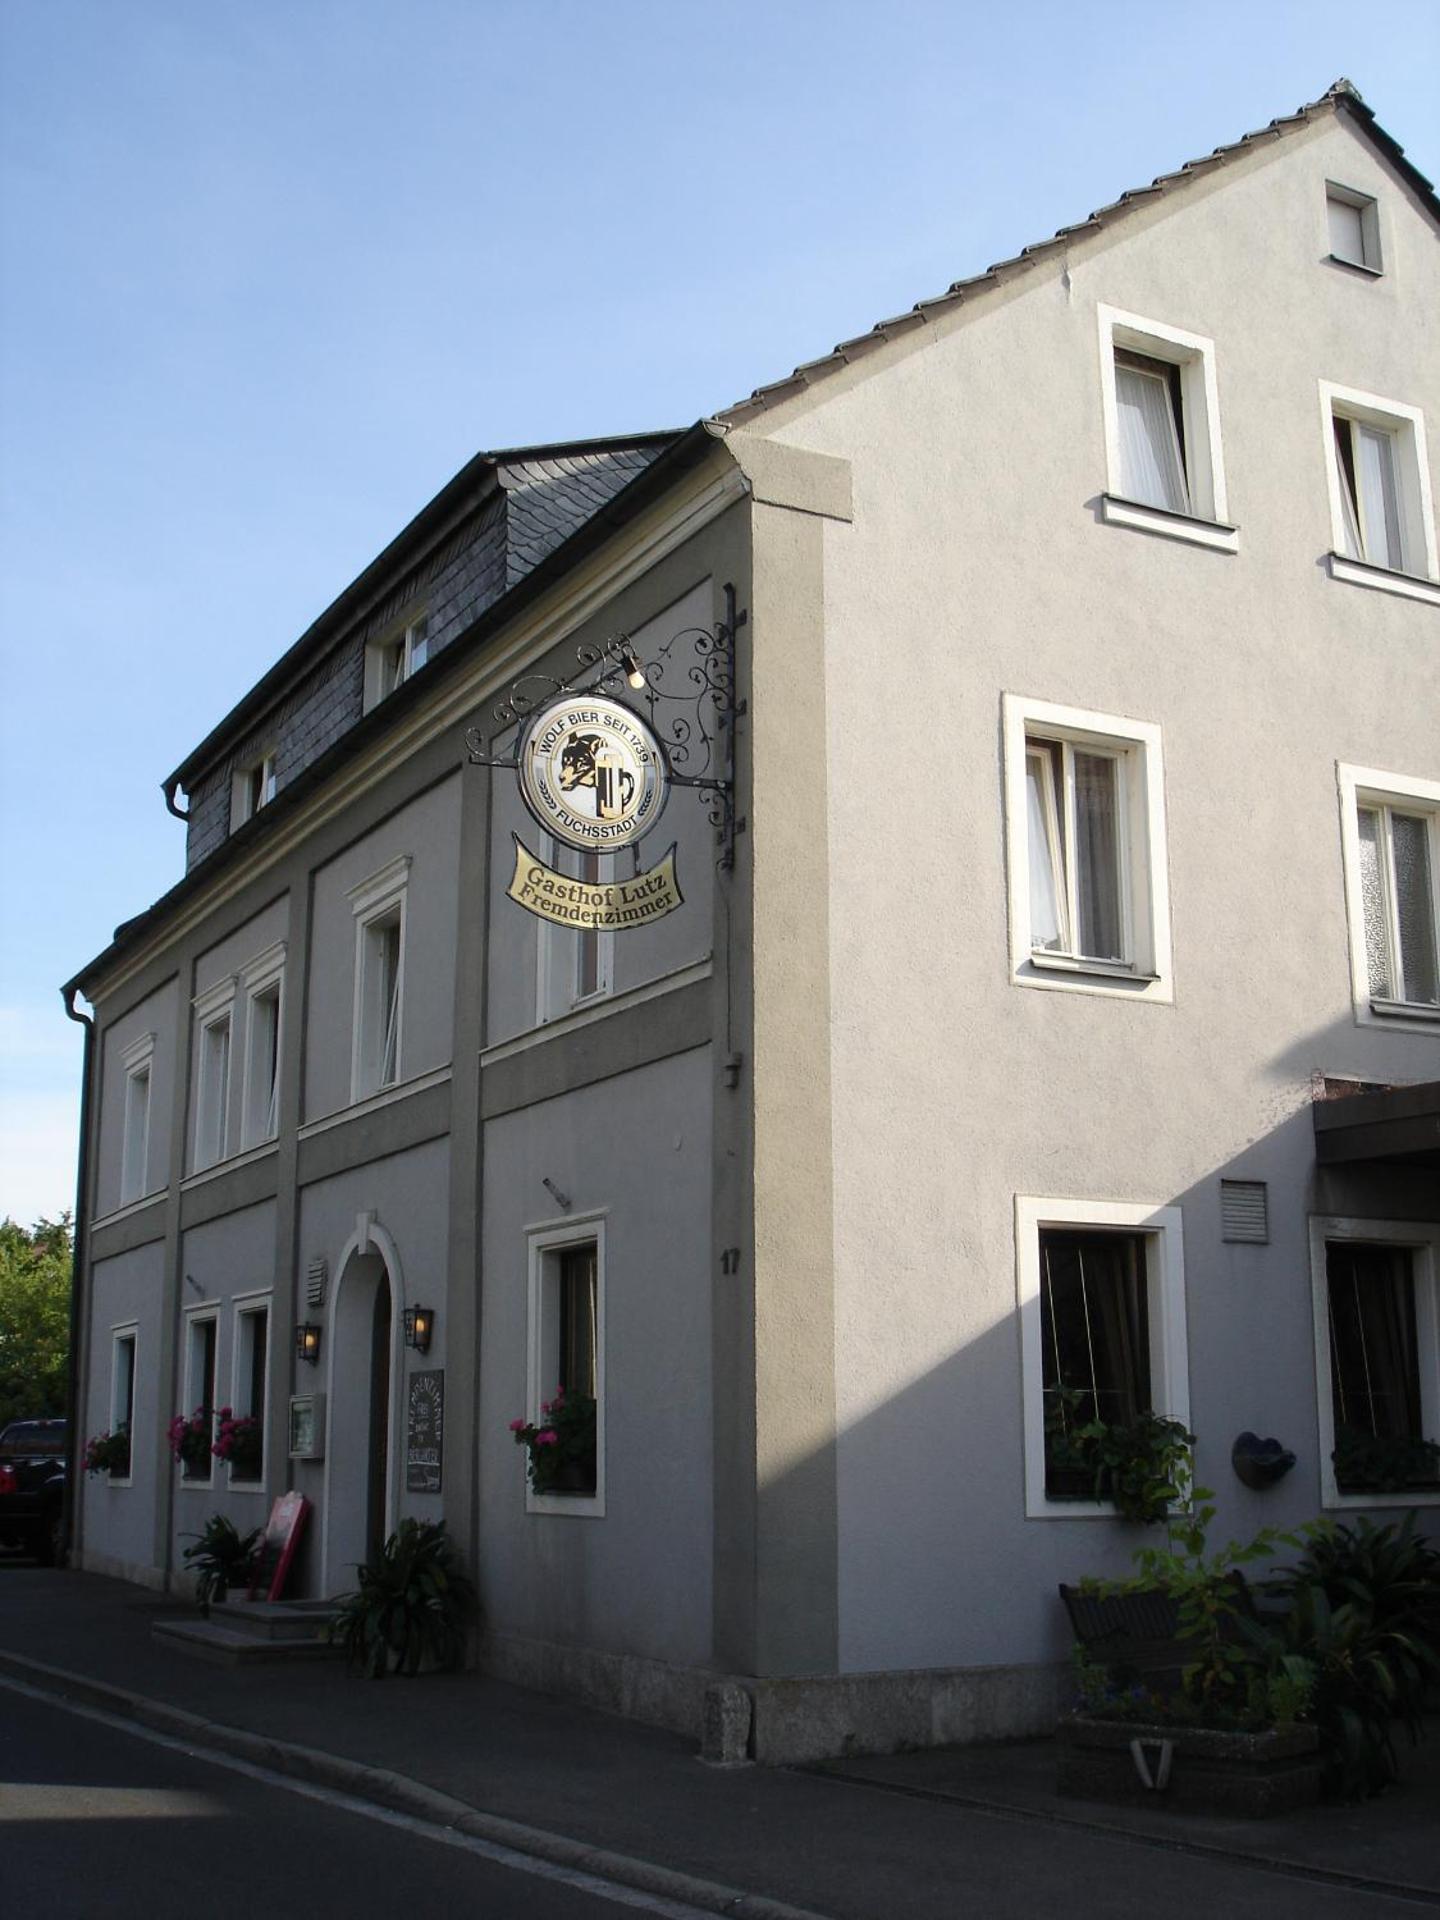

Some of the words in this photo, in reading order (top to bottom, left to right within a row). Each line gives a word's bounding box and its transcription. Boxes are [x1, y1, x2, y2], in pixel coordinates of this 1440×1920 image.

[540, 719, 565, 754] WOLF
[568, 711, 599, 726] BIER
[603, 714, 631, 736] SEIT
[630, 734, 649, 763] 1739
[556, 810, 638, 838] FUCHSSTADT
[518, 883, 674, 924] Fremdenzimmer
[527, 866, 613, 906] Gasthof
[621, 873, 668, 904] Lutz
